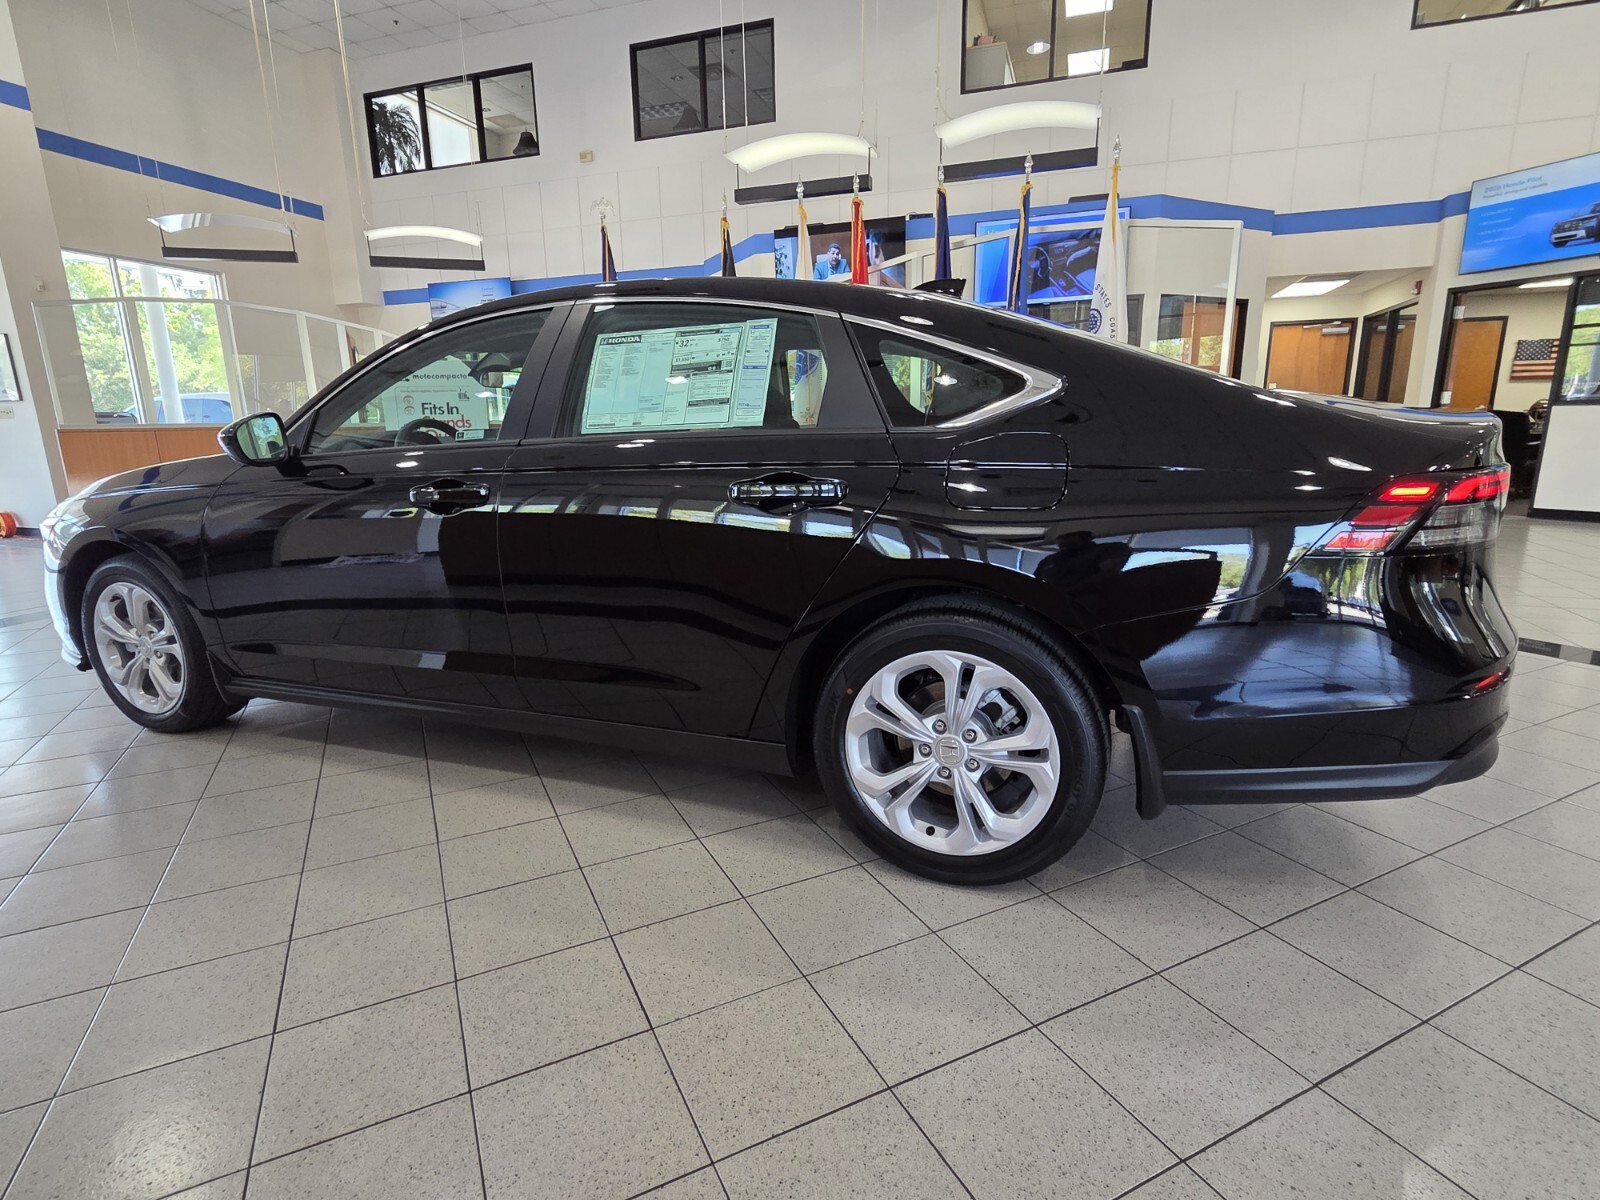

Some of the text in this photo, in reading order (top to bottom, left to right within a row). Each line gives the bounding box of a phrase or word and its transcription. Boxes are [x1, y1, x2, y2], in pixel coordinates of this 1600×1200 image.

[1095, 284, 1112, 308] STATES
[608, 336, 641, 344] HONDA
[679, 340, 690, 348] 32
[421, 402, 459, 415] Fits In
